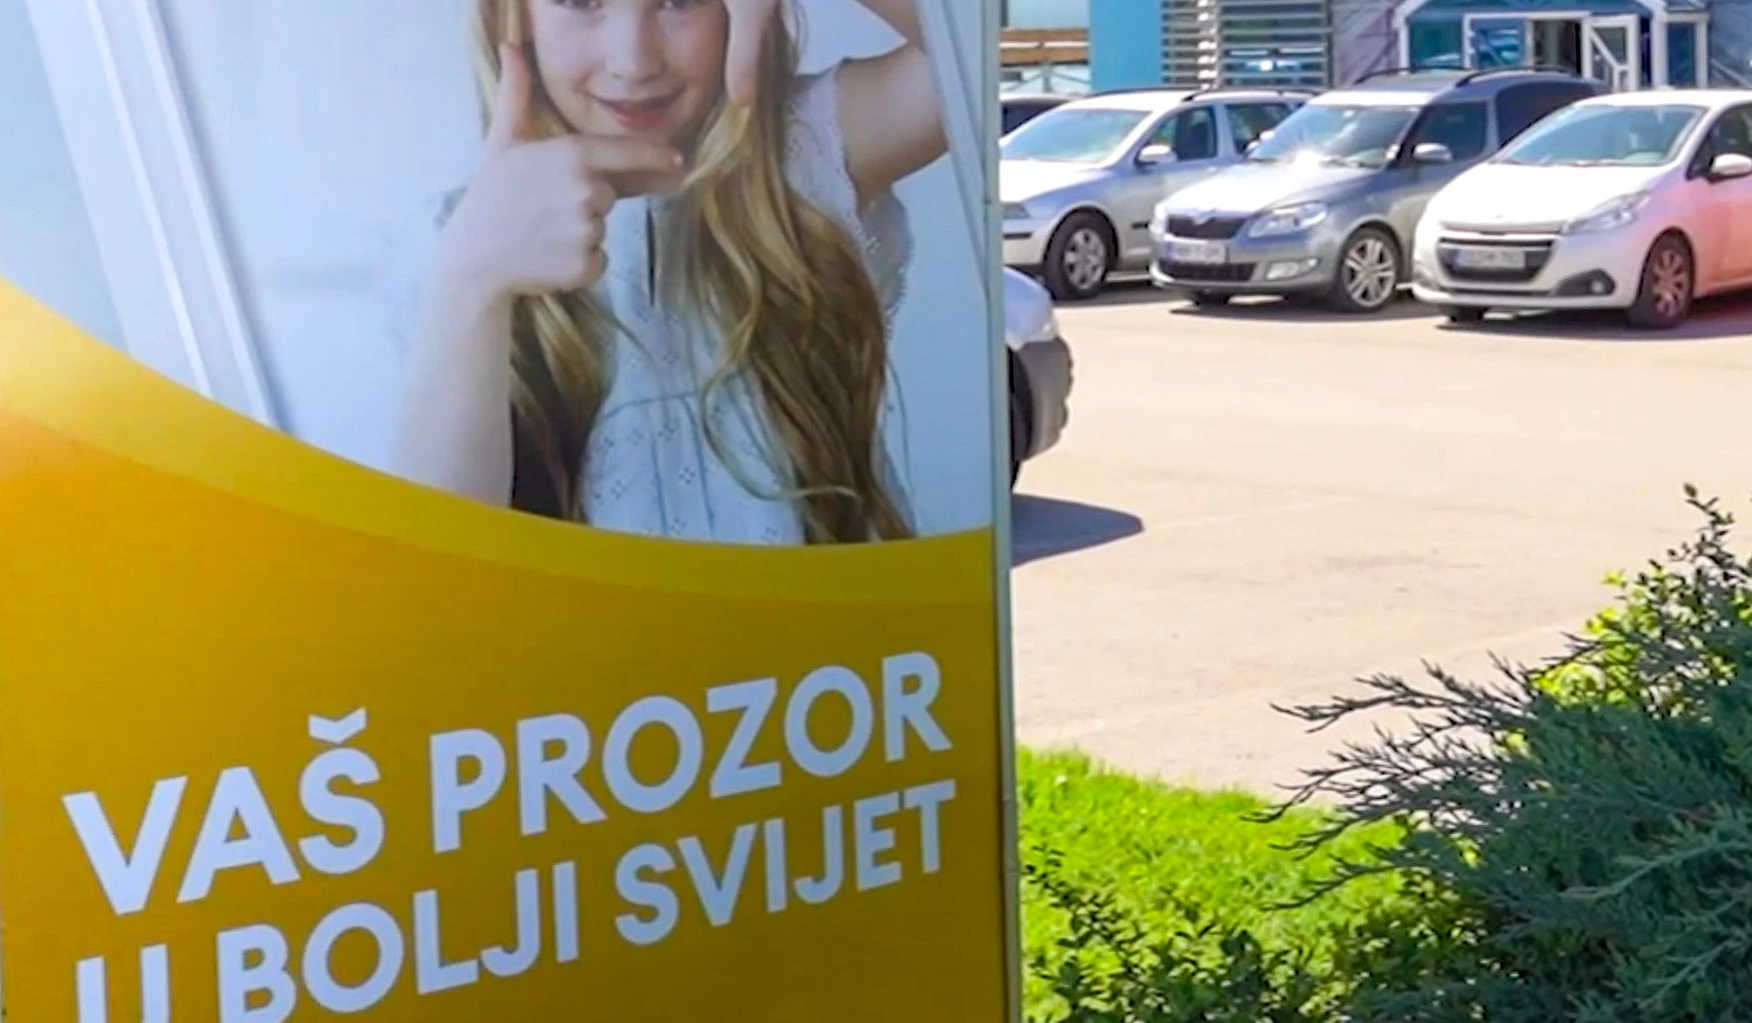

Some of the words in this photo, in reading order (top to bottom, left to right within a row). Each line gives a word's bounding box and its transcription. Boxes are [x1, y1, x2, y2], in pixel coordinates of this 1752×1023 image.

[62, 707, 385, 915] VAŠ
[430, 651, 953, 853] PROZOR
[216, 860, 580, 1023] BOLJI
[614, 779, 957, 946] SVIJET
